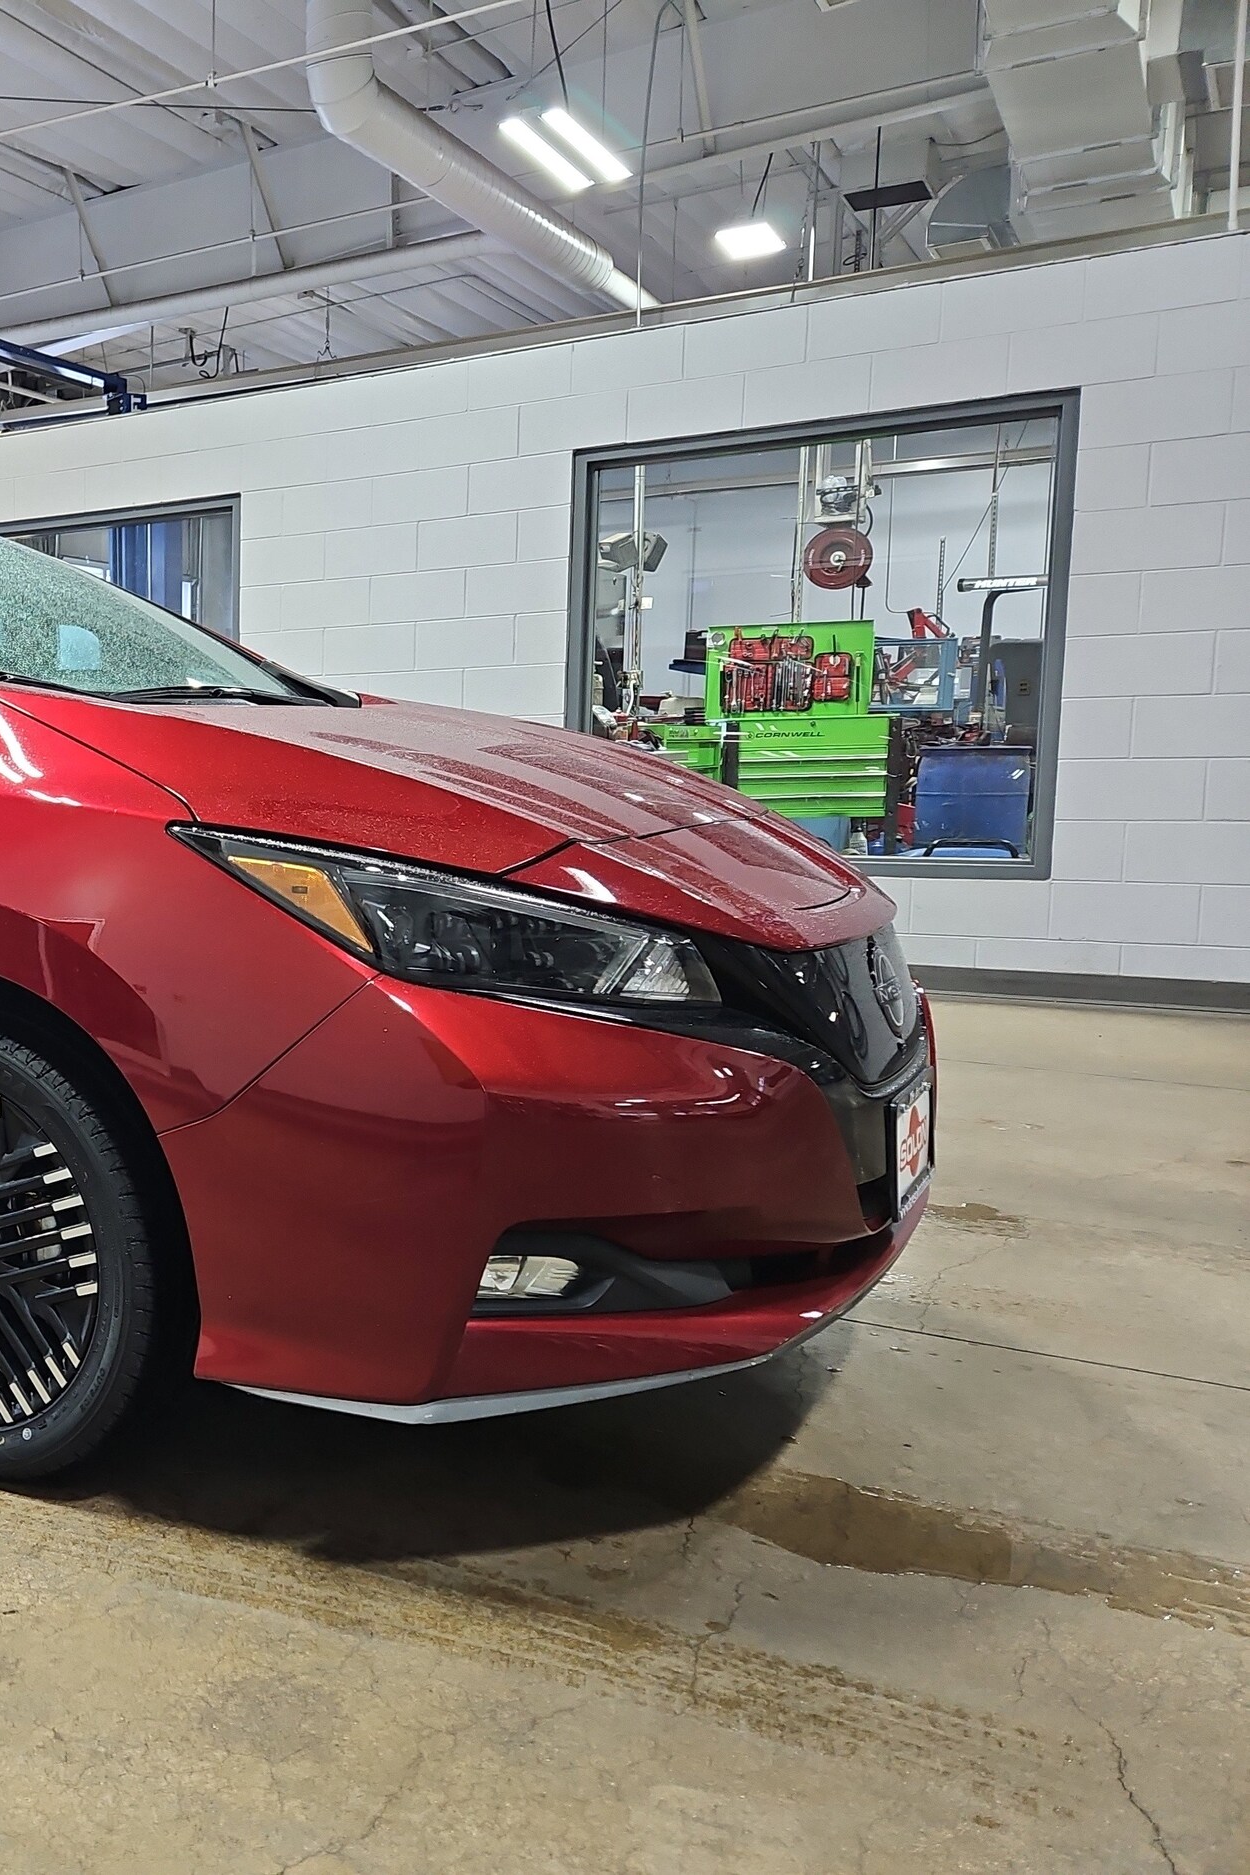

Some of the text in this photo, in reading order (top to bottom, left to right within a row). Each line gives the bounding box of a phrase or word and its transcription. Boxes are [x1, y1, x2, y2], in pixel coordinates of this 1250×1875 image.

[973, 577, 1038, 589] HUNTER
[755, 731, 825, 739] CORNWELL
[899, 1117, 928, 1172] SOLON
